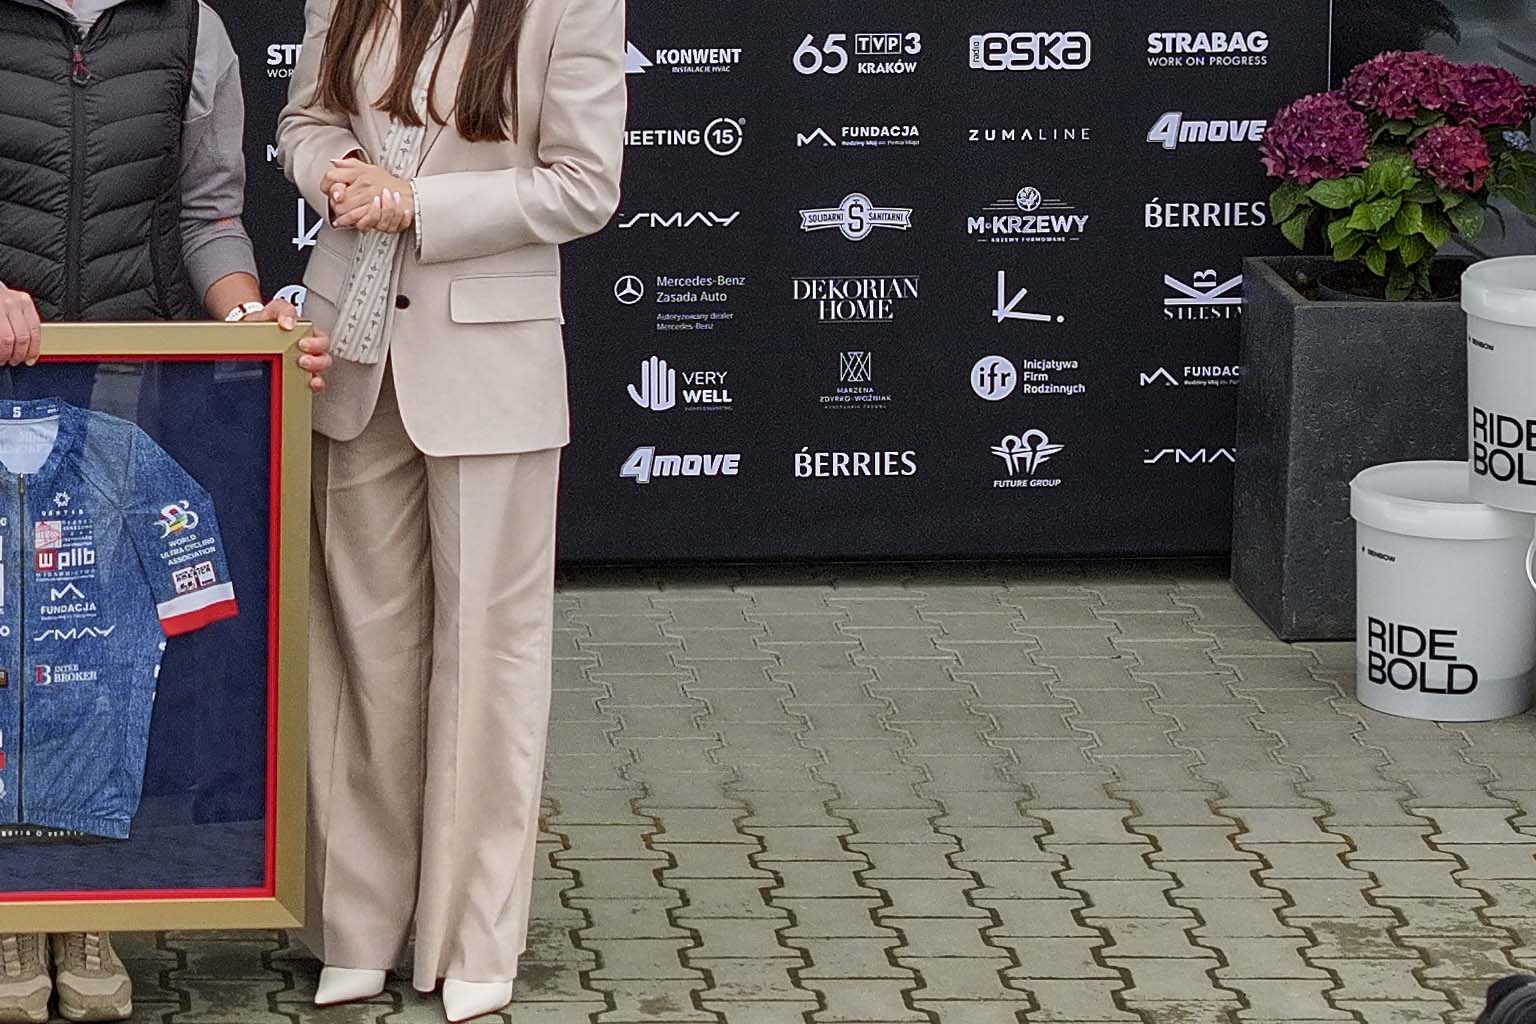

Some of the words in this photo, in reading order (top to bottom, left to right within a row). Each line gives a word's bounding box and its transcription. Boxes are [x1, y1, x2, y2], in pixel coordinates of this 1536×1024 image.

[1147, 30, 1269, 54] STRABAG
[968, 127, 1090, 142] ZUMALINE
[793, 278, 919, 302] DEKORIAN
[819, 299, 894, 320] HOME
[681, 371, 728, 385] VERY
[682, 389, 733, 404] WELL
[1474, 441, 1536, 486] BOL
[41, 602, 97, 616] FUNDACJA
[1368, 617, 1458, 661] RIDE
[54, 671, 97, 682] BROKER
[1368, 652, 1478, 695] BOLD
